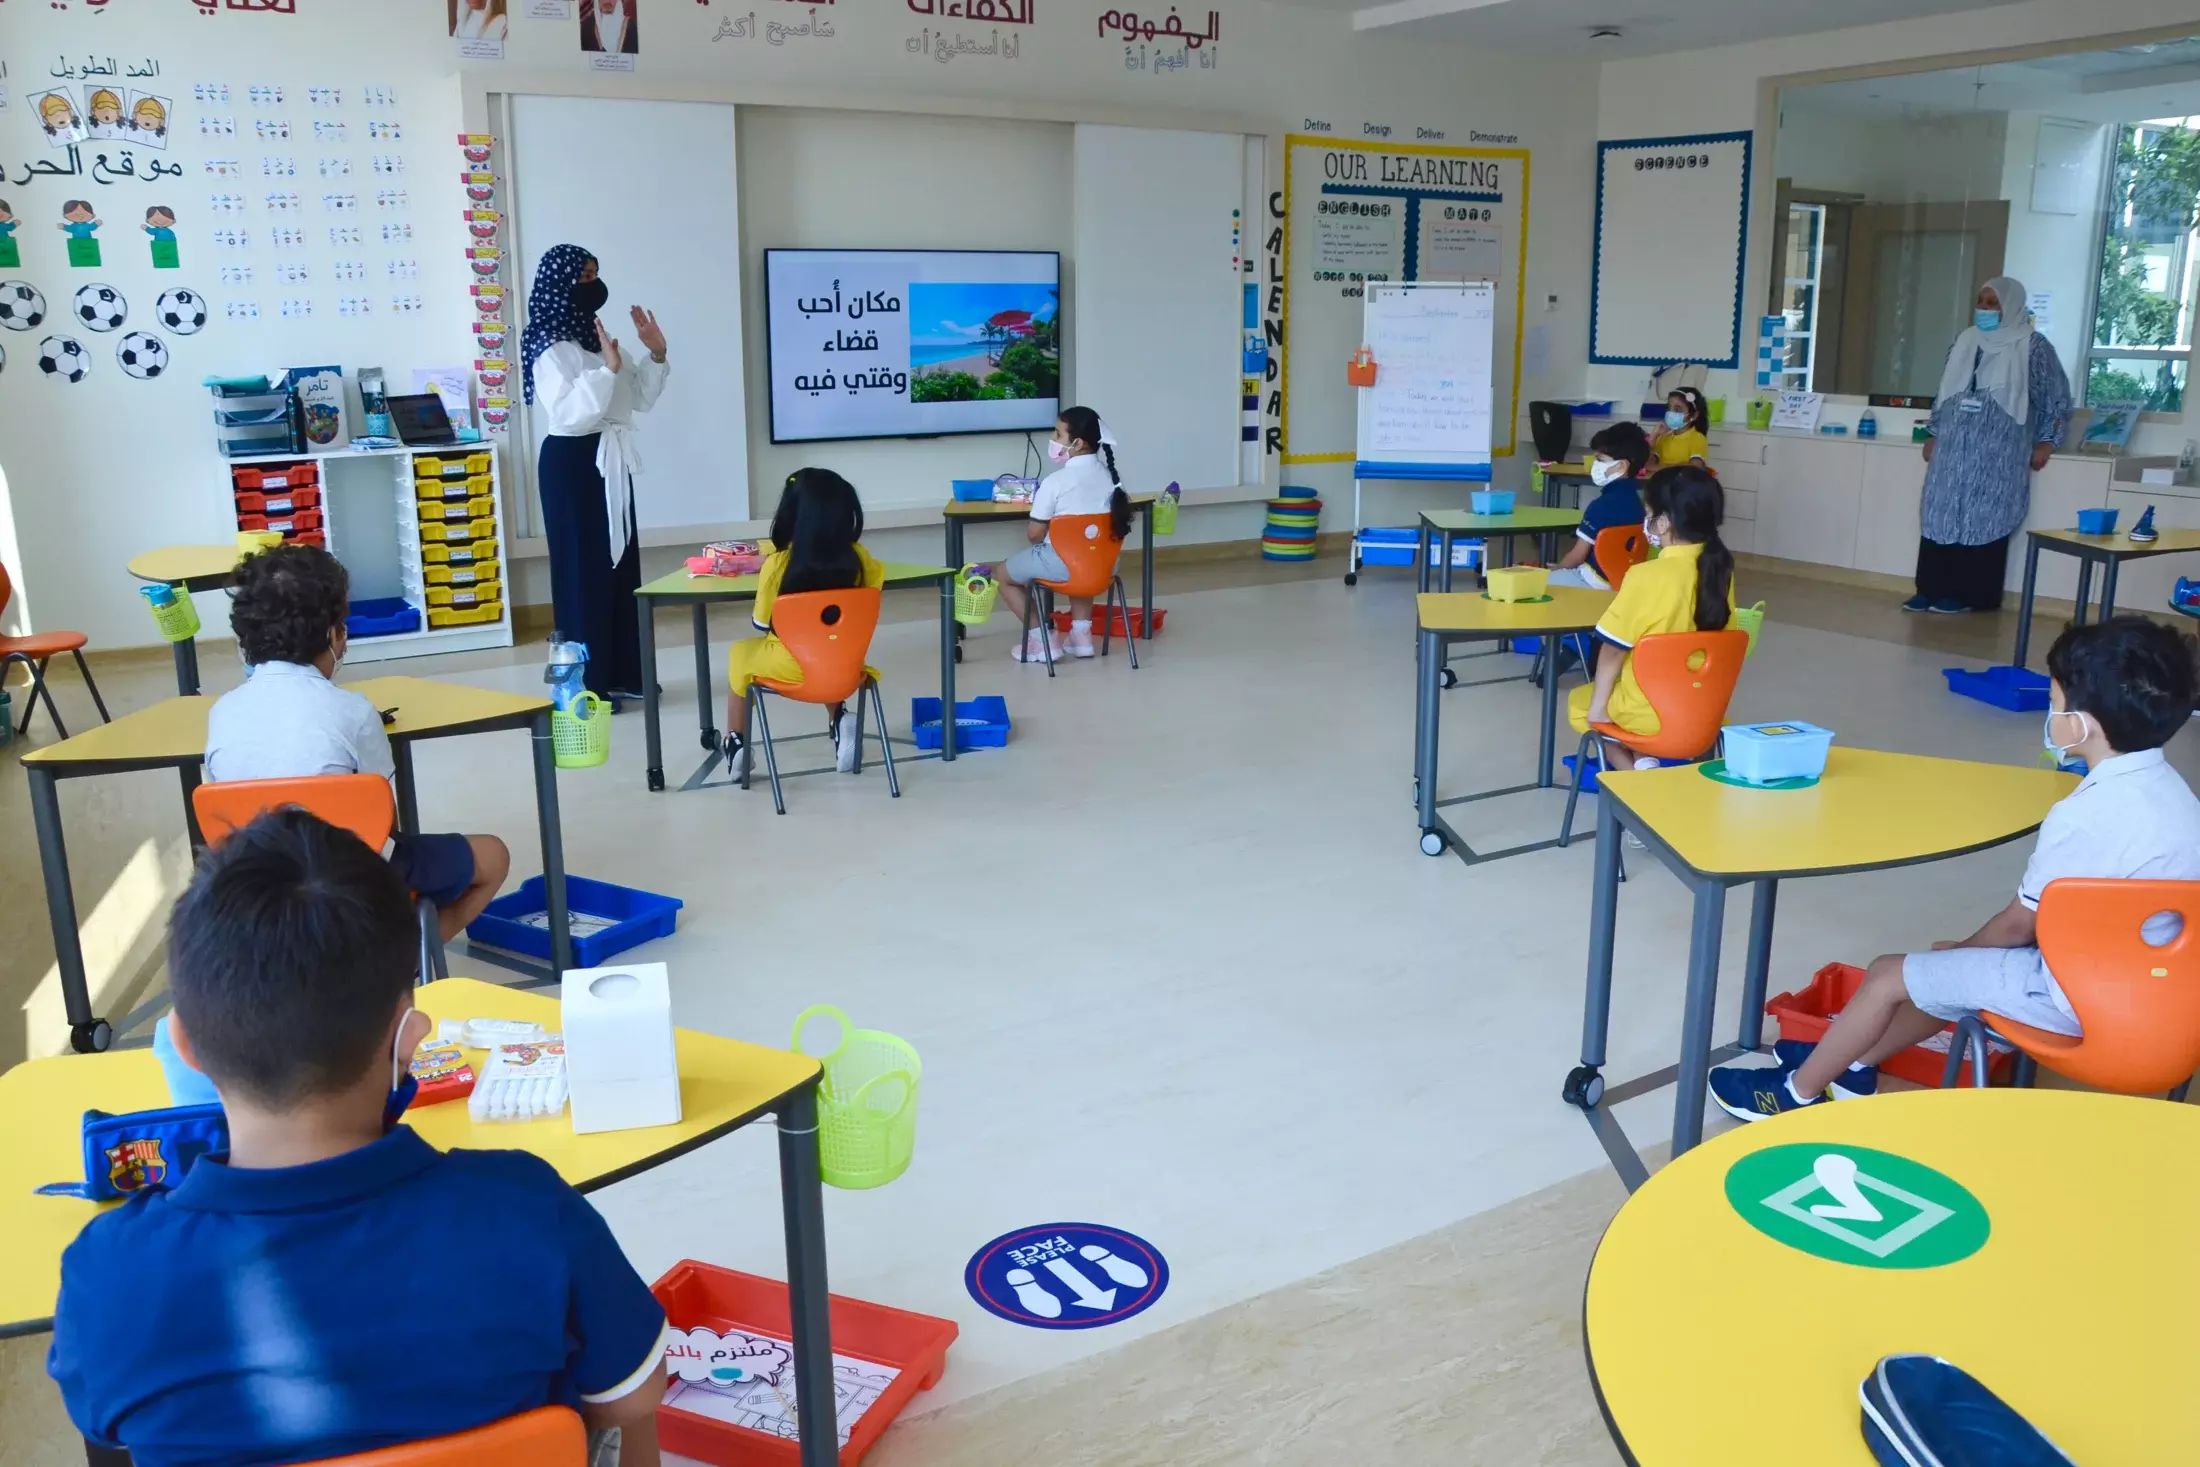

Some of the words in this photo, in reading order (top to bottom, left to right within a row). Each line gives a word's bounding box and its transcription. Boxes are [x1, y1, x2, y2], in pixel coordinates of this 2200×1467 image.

[1098, 6, 1219, 49] المفهوم
[50, 54, 117, 80] الطويل
[126, 58, 160, 77] المد
[1304, 118, 1331, 131] Define
[1364, 122, 1392, 136] Design
[1417, 127, 1445, 139] Deliver
[1470, 130, 1518, 143] Demonstrate
[0, 143, 82, 186] الحر
[92, 149, 183, 185] موقع
[1324, 152, 1368, 180] OUR
[1381, 156, 1499, 189] LEARNING
[1634, 154, 1709, 171] SCIENCE
[1318, 200, 1391, 217] ENGLISH
[1444, 206, 1491, 222] MATH
[848, 290, 901, 319] مكان
[1264, 191, 1286, 455] CALENDAR
[823, 330, 878, 352] قضاء
[306, 377, 329, 396] تامر
[794, 369, 836, 396] فيه
[843, 367, 907, 395] وقتي
[1006, 1235, 1068, 1261] FACE
[1016, 1244, 1076, 1268] PLEASE
[665, 1344, 701, 1361] بالك
[710, 1345, 773, 1363] ملتزم
